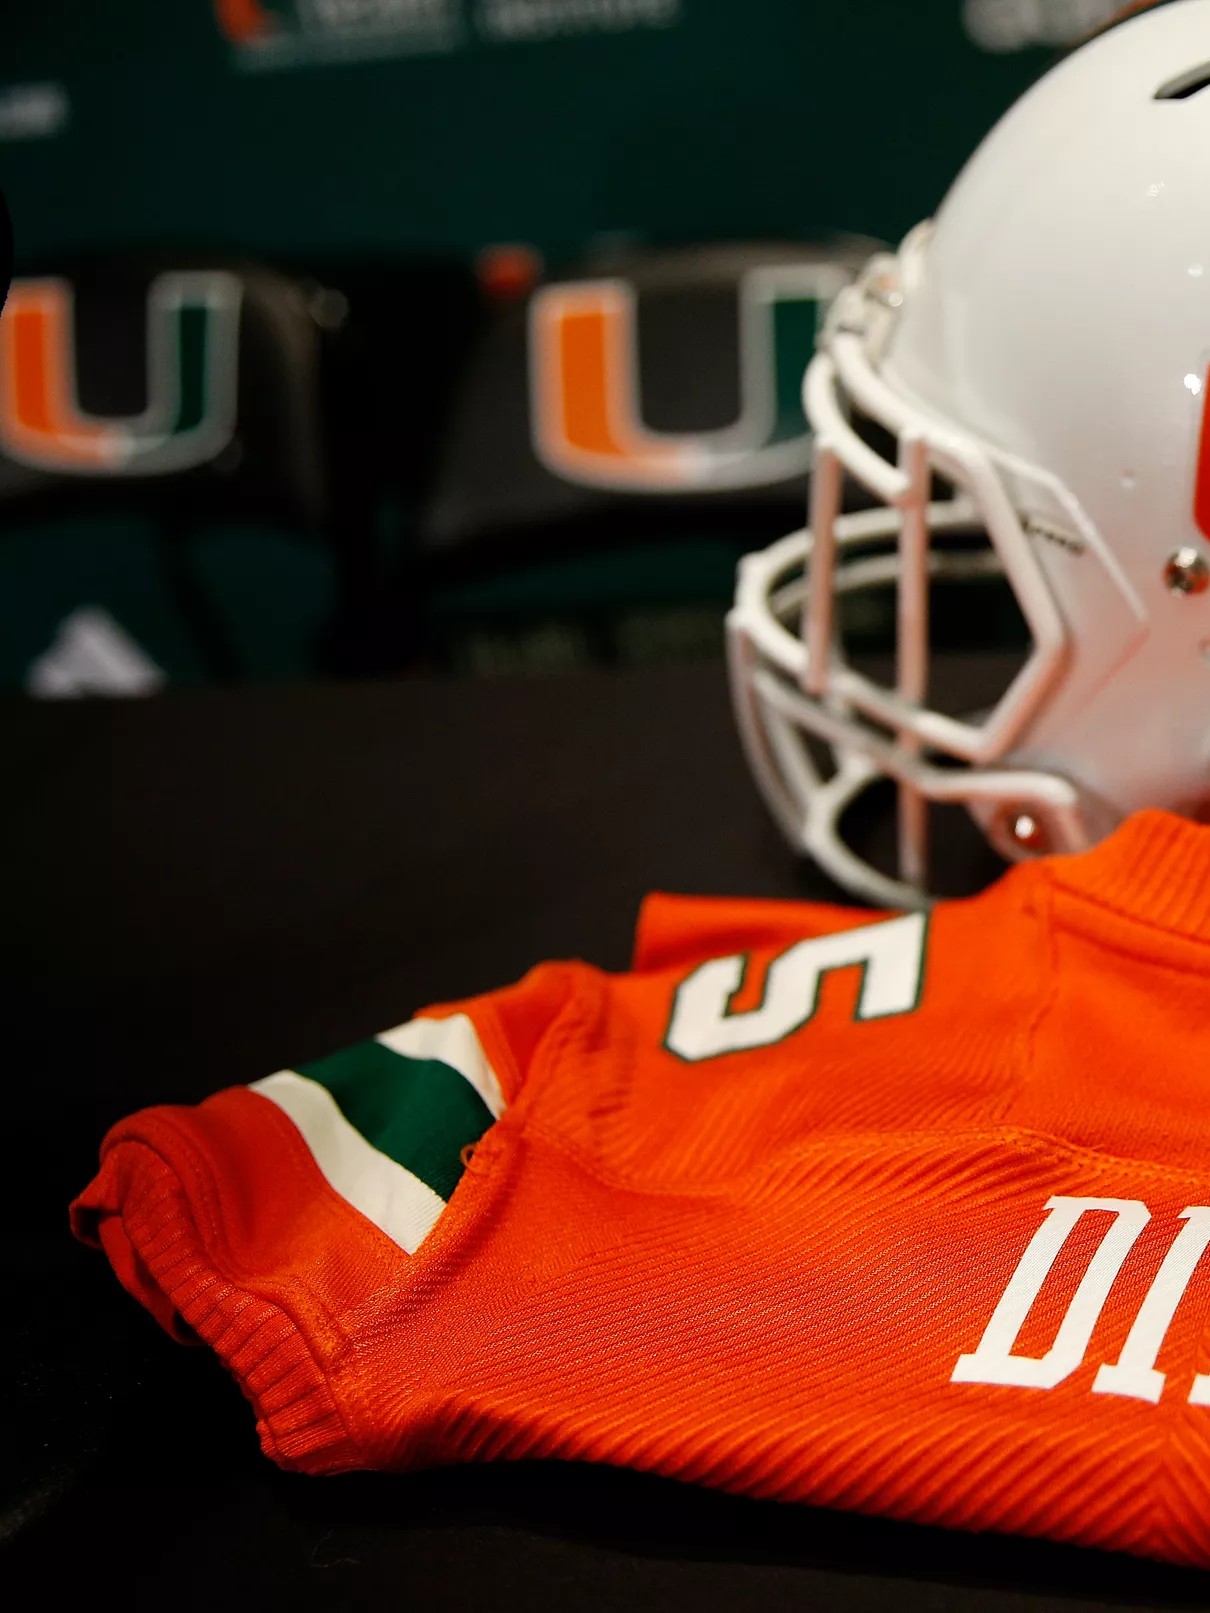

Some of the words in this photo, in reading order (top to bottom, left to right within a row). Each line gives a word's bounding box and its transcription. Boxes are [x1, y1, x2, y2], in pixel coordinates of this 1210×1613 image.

[0, 271, 240, 478] U
[526, 266, 848, 492] U
[661, 908, 930, 1066] 5
